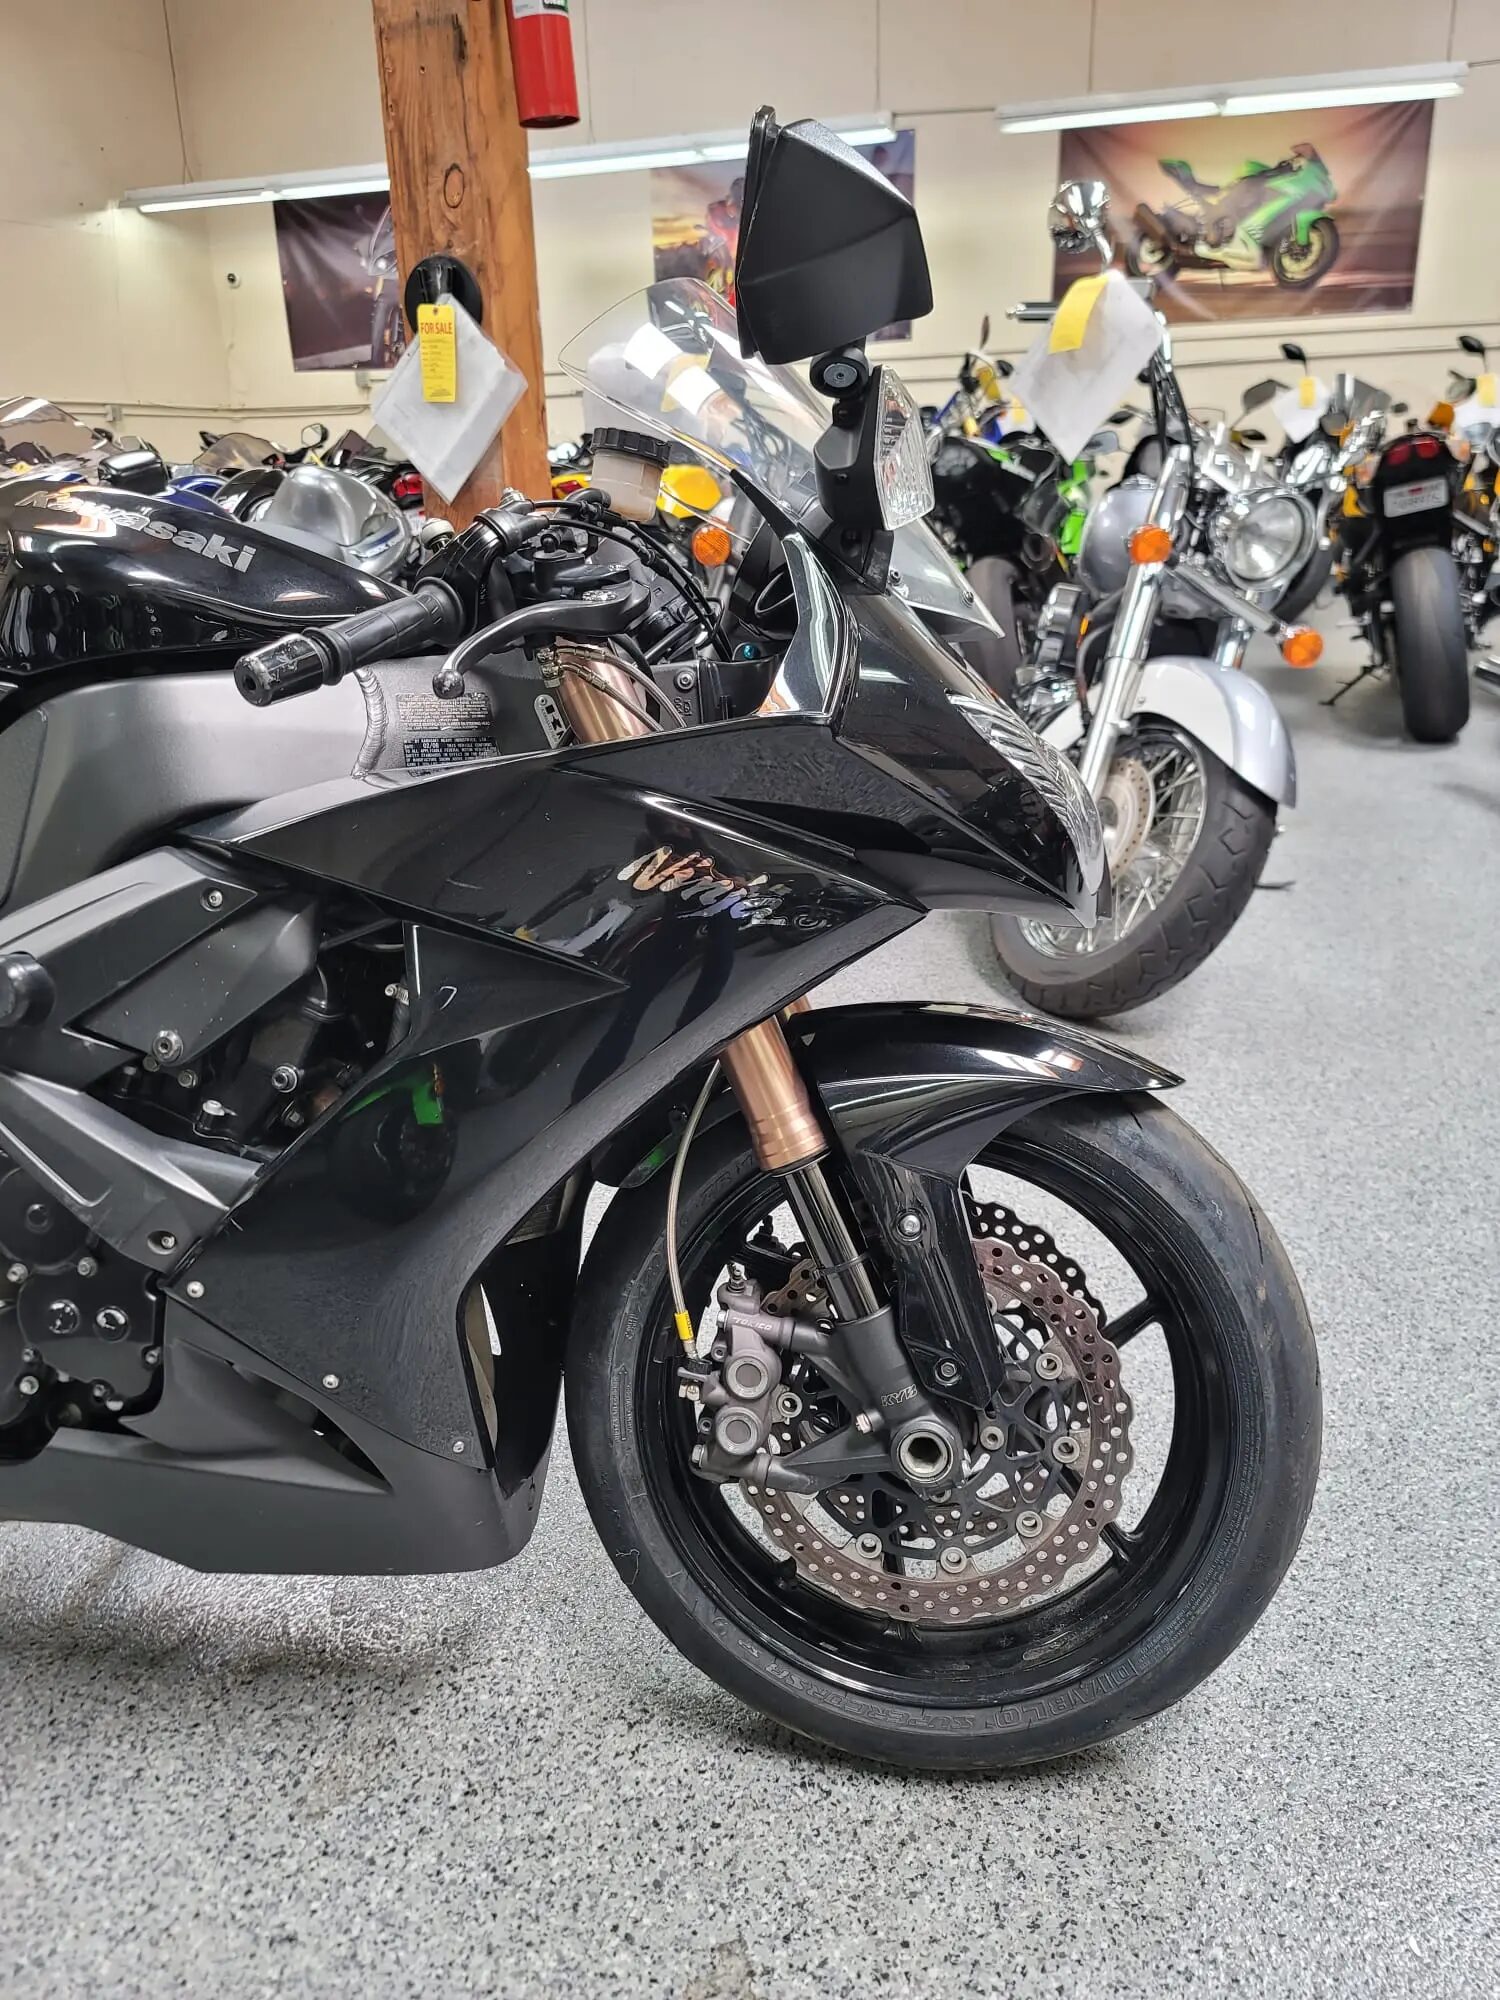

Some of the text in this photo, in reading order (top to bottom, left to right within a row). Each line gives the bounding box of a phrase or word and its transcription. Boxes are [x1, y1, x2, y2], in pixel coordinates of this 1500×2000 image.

[420, 322, 453, 335] FOR SALE
[14, 490, 257, 573] Kawasaki
[616, 845, 786, 932] Ninja
[880, 1383, 918, 1407] KYB
[993, 1662, 1133, 1729] DIABLO
